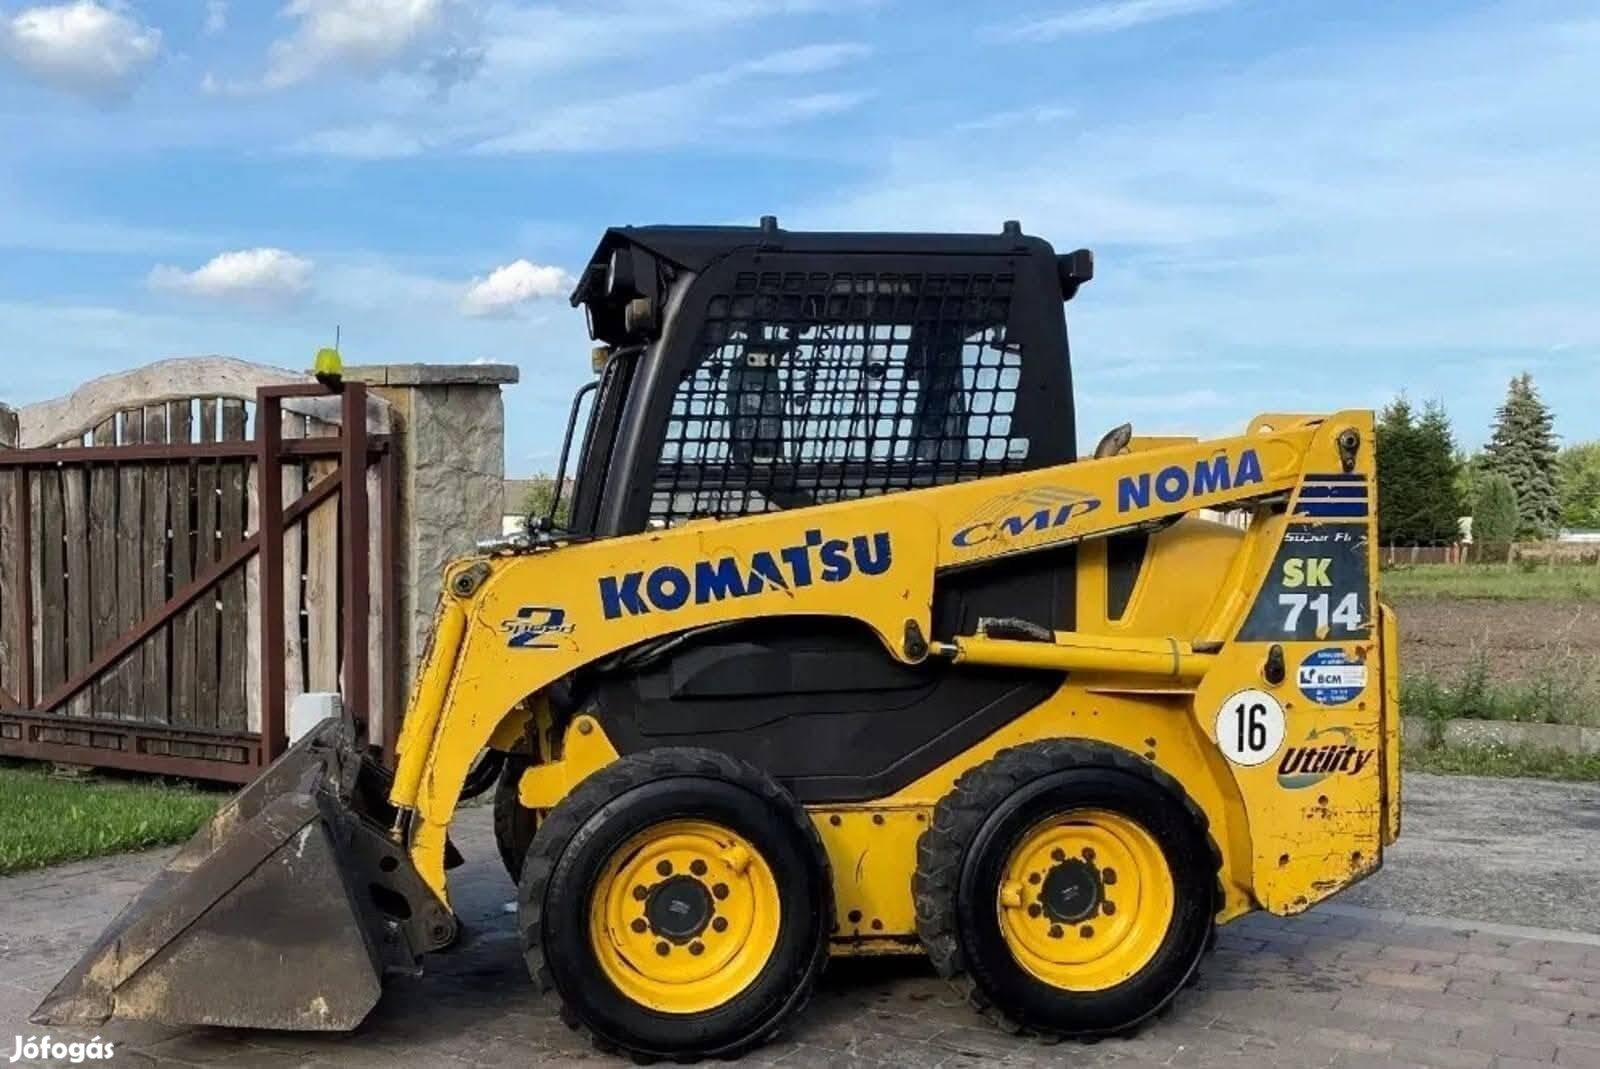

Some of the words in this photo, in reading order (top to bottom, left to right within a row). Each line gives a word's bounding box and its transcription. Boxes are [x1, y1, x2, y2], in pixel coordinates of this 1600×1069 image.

[952, 499, 1101, 547] CMP
[1118, 448, 1263, 512] NOMA
[598, 529, 892, 620] KOMATSU
[1282, 558, 1333, 587] SK
[508, 607, 565, 648] 2
[1279, 592, 1361, 634] 714
[1235, 703, 1267, 753] 16
[1278, 745, 1374, 776] Utility
